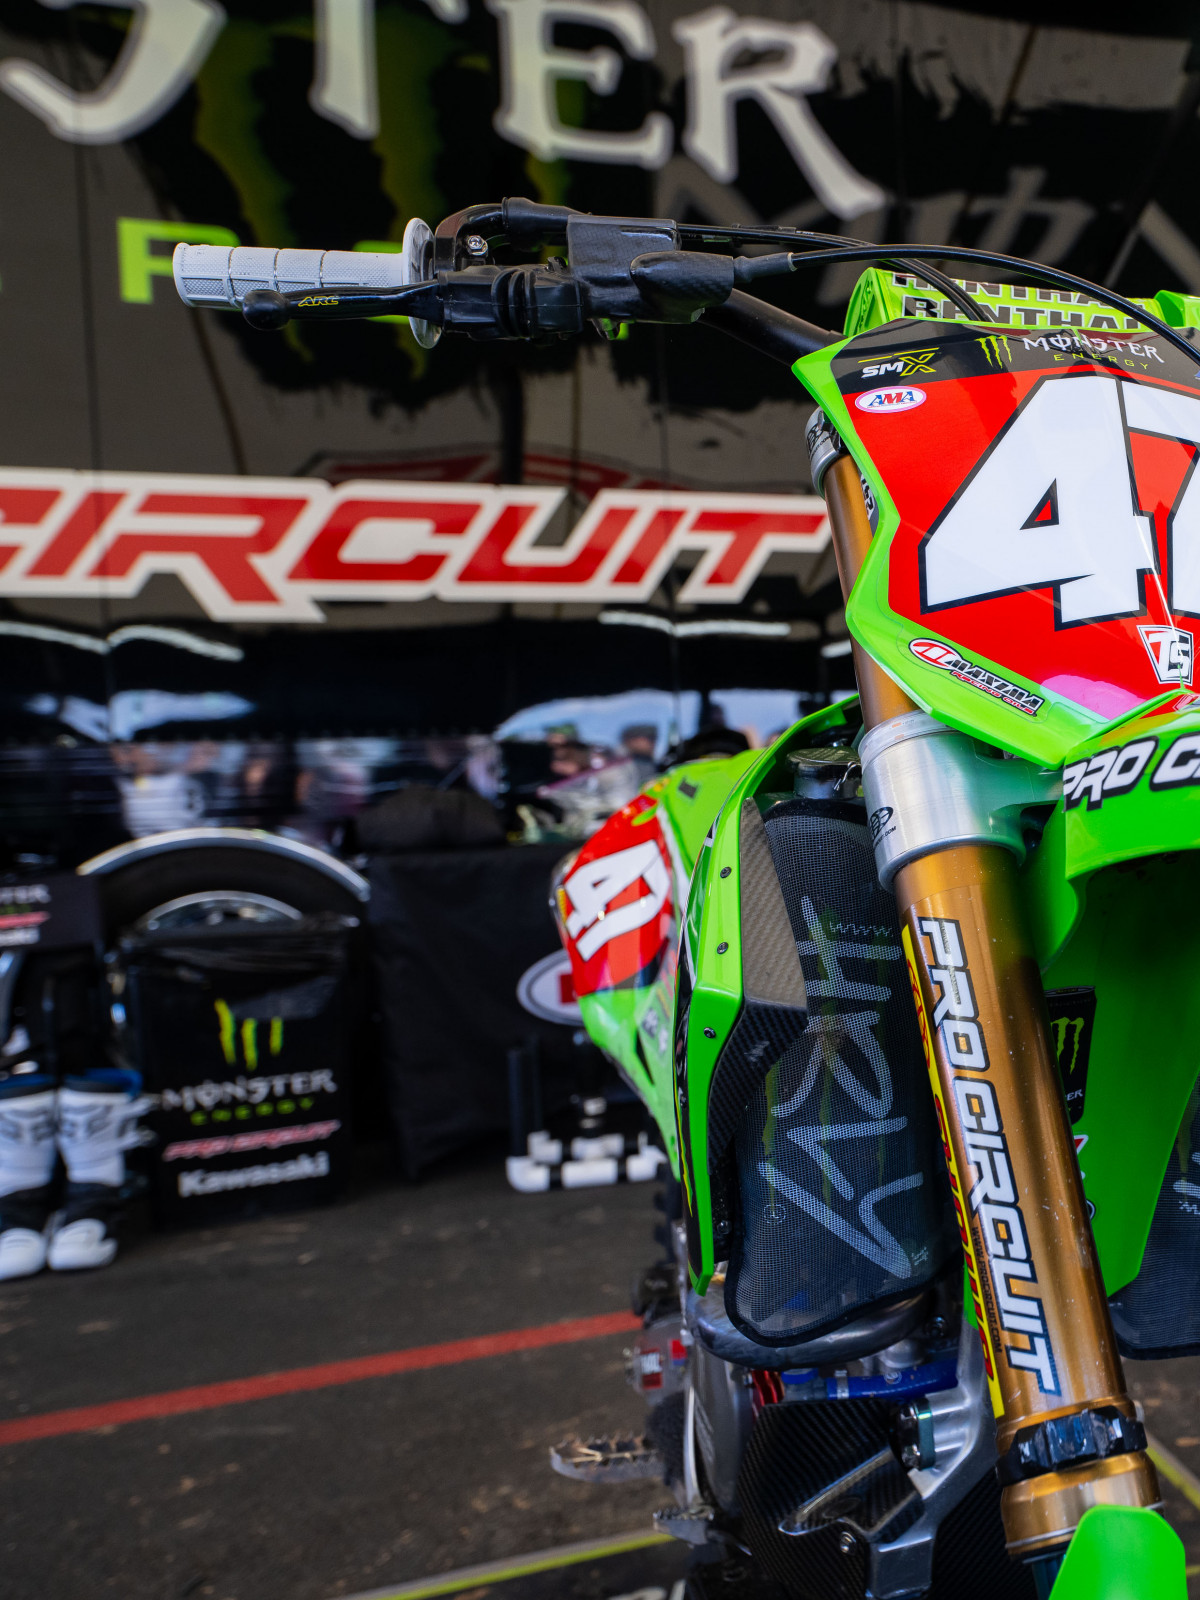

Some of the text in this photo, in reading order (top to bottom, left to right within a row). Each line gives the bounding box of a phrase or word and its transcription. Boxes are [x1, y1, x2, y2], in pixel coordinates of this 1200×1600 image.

[1023, 333, 1165, 364] MONSTER
[1053, 352, 1150, 371] ENERGY
[861, 352, 937, 379] SMX
[867, 390, 916, 407] AMA
[161, 1068, 339, 1113] MONSTER
[917, 916, 1062, 1397] PRO CIRCUIT
[178, 1150, 330, 1198] Kawasaki
